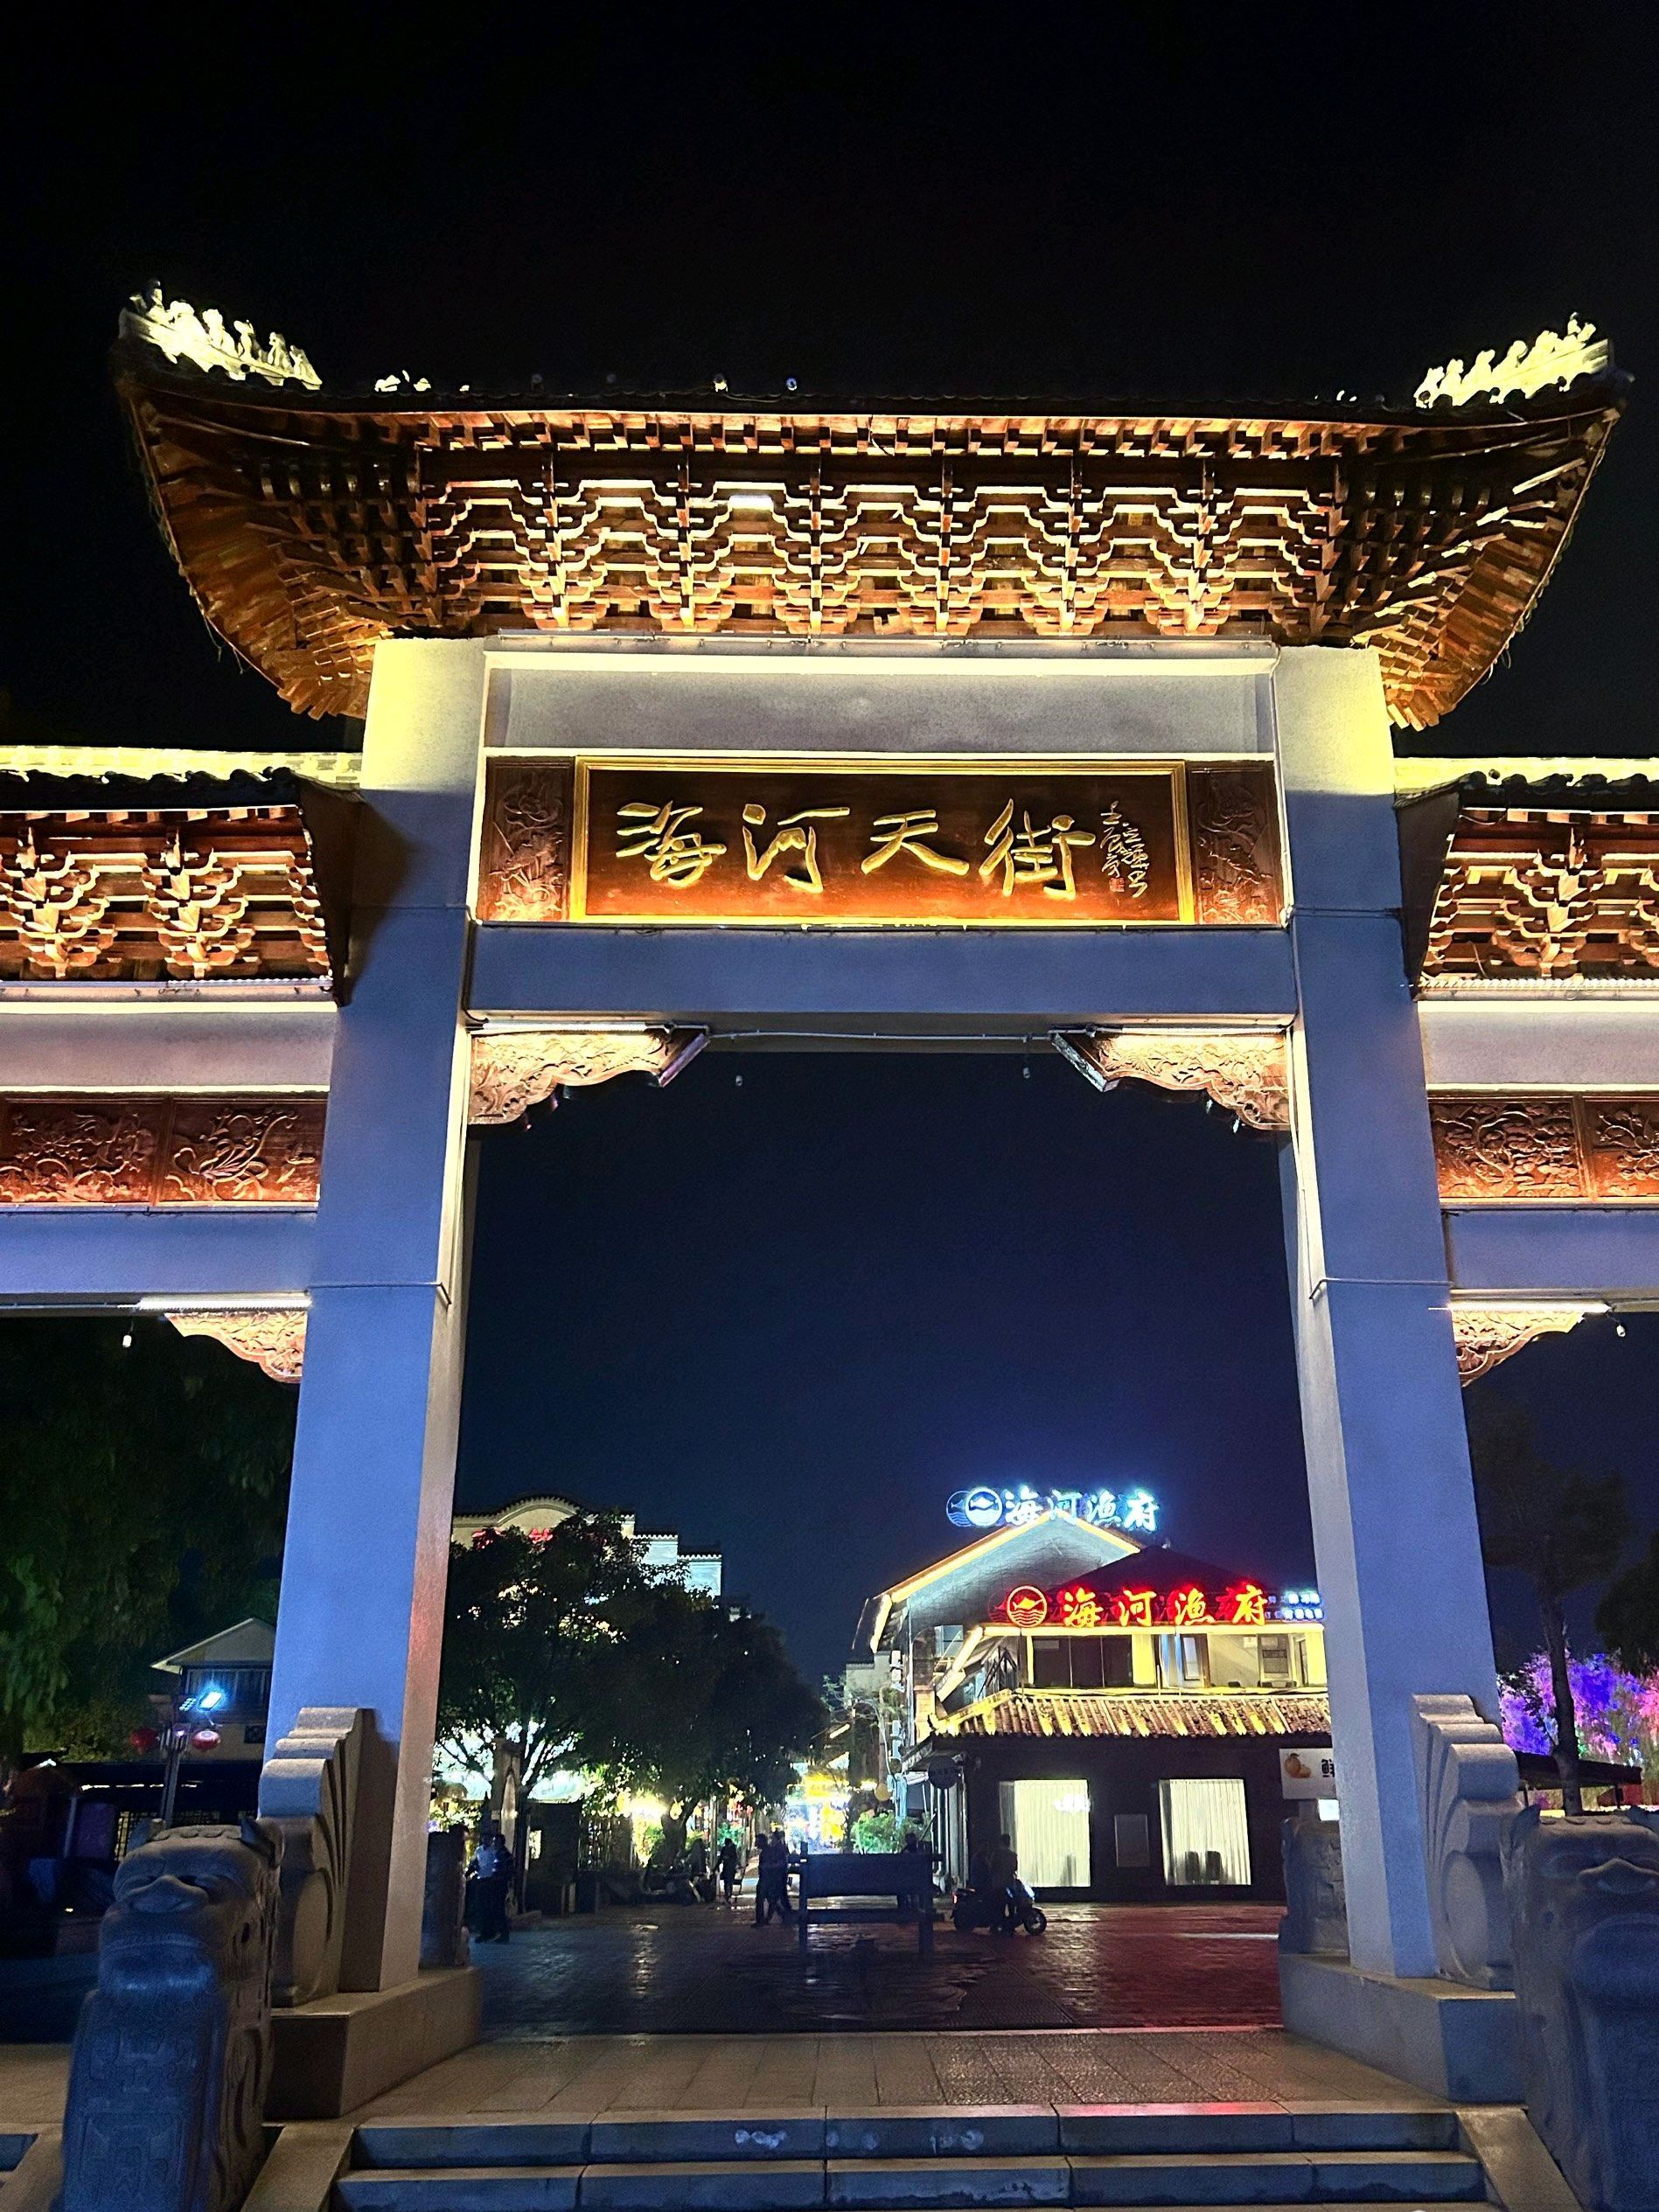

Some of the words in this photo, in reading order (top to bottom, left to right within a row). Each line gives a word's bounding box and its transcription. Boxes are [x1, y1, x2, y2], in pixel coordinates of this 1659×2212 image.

[617, 799, 1096, 900] 海河天街
[1006, 1485, 1160, 1531] 海河渔府
[1064, 1585, 1268, 1626] 海河渔府
